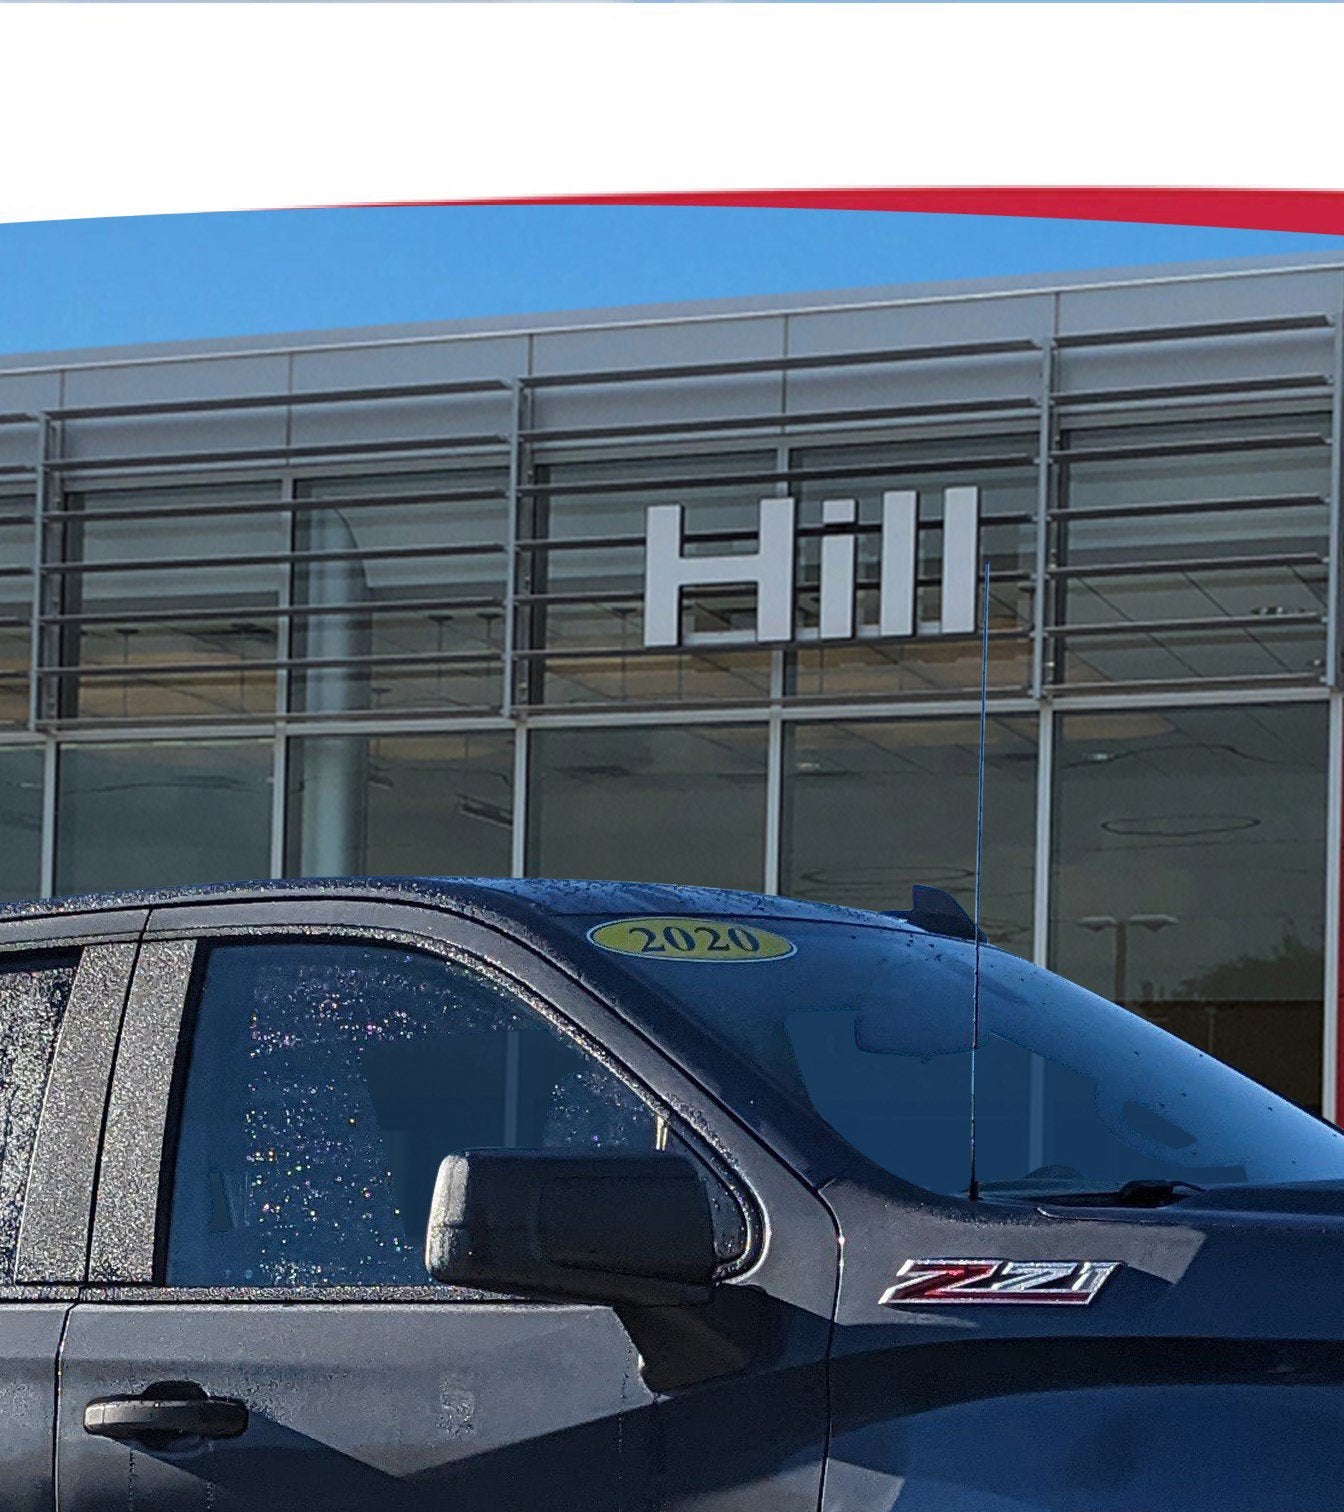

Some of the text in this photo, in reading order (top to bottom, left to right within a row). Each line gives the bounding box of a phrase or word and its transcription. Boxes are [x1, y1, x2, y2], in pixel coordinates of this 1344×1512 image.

[643, 486, 980, 647] Hill
[628, 925, 762, 953] 2020
[877, 1258, 1124, 1305] Z71
